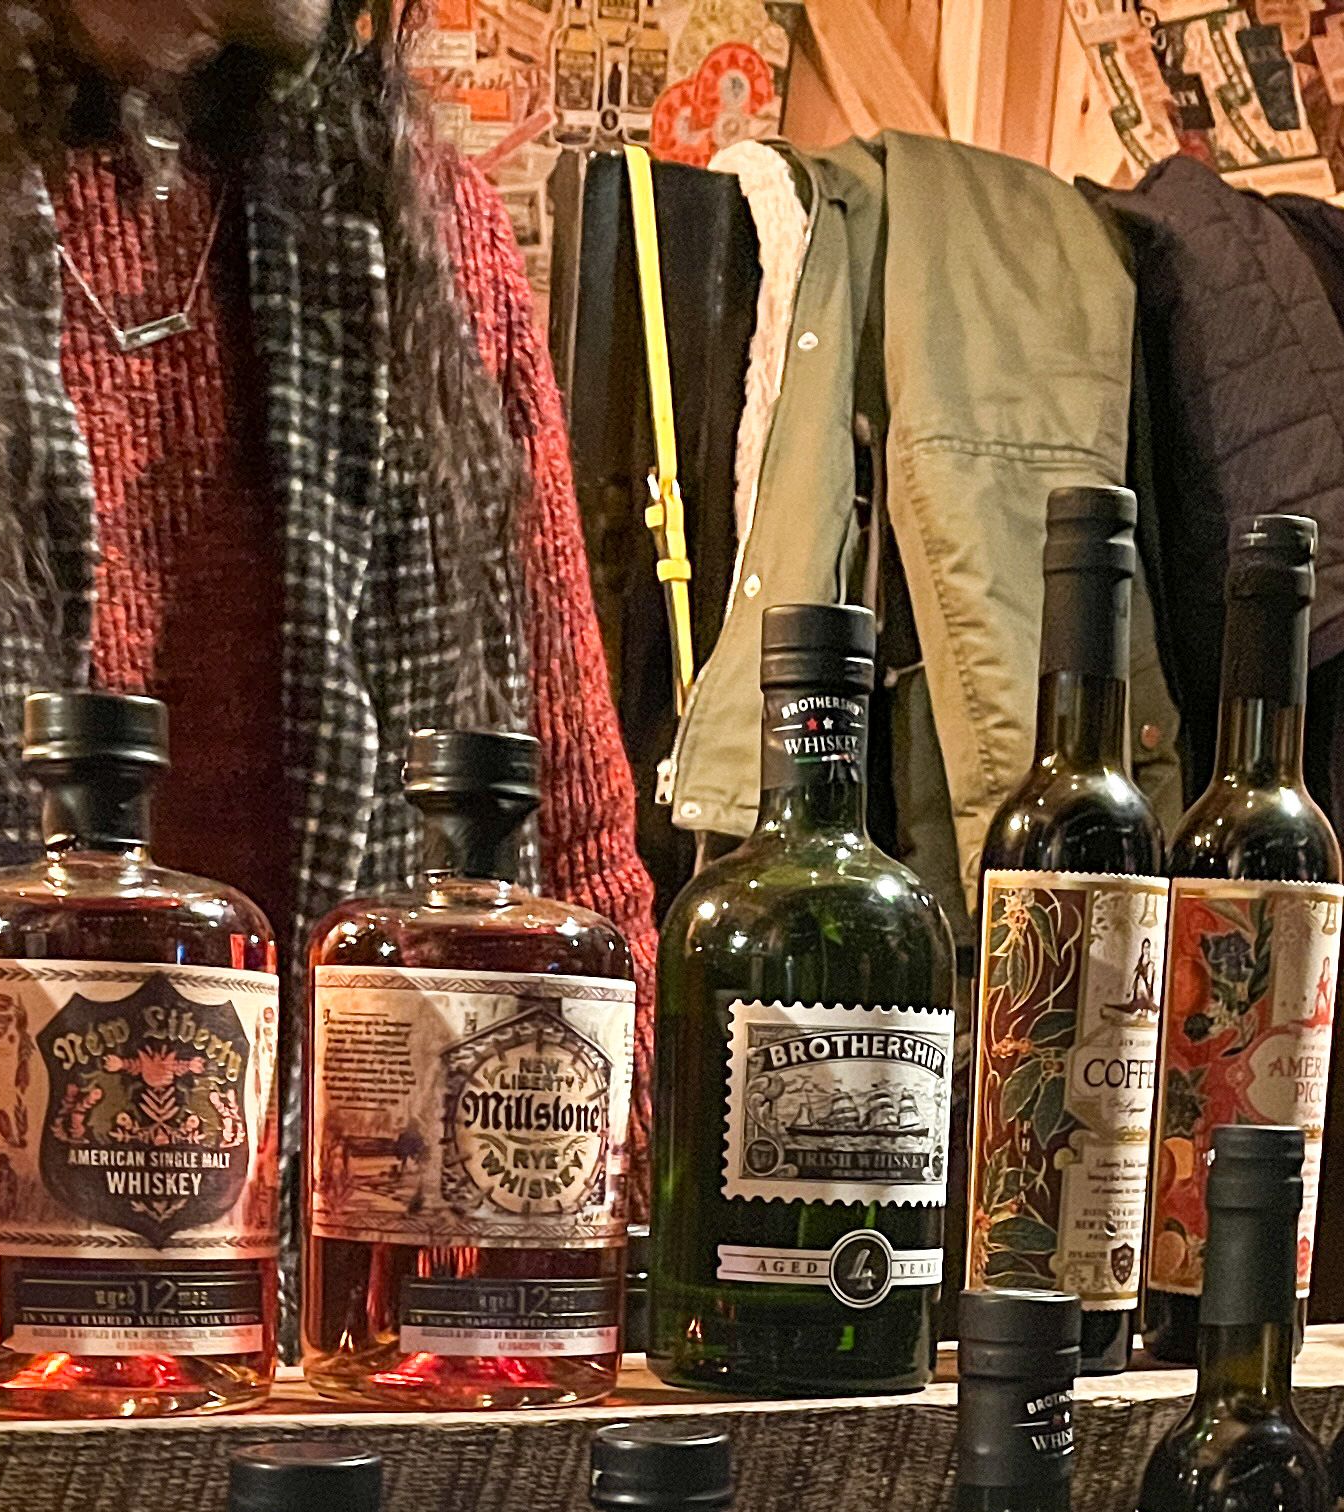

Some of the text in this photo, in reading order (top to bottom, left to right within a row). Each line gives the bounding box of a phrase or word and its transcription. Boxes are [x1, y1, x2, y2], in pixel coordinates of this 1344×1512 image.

[519, 1056, 562, 1075] NEW
[768, 1035, 945, 1072] BROTHERSHIP
[461, 1089, 603, 1135] Millstone
[67, 1147, 232, 1169] AMERICAN SINGLE MALT
[512, 1148, 558, 1169] RYE
[106, 1170, 204, 1197] WHISKEY
[479, 1148, 586, 1203] WHISKEY
[756, 1257, 819, 1275] AGED
[847, 1247, 877, 1291] 4
[137, 1279, 179, 1314] 12
[516, 1285, 551, 1317] 12
